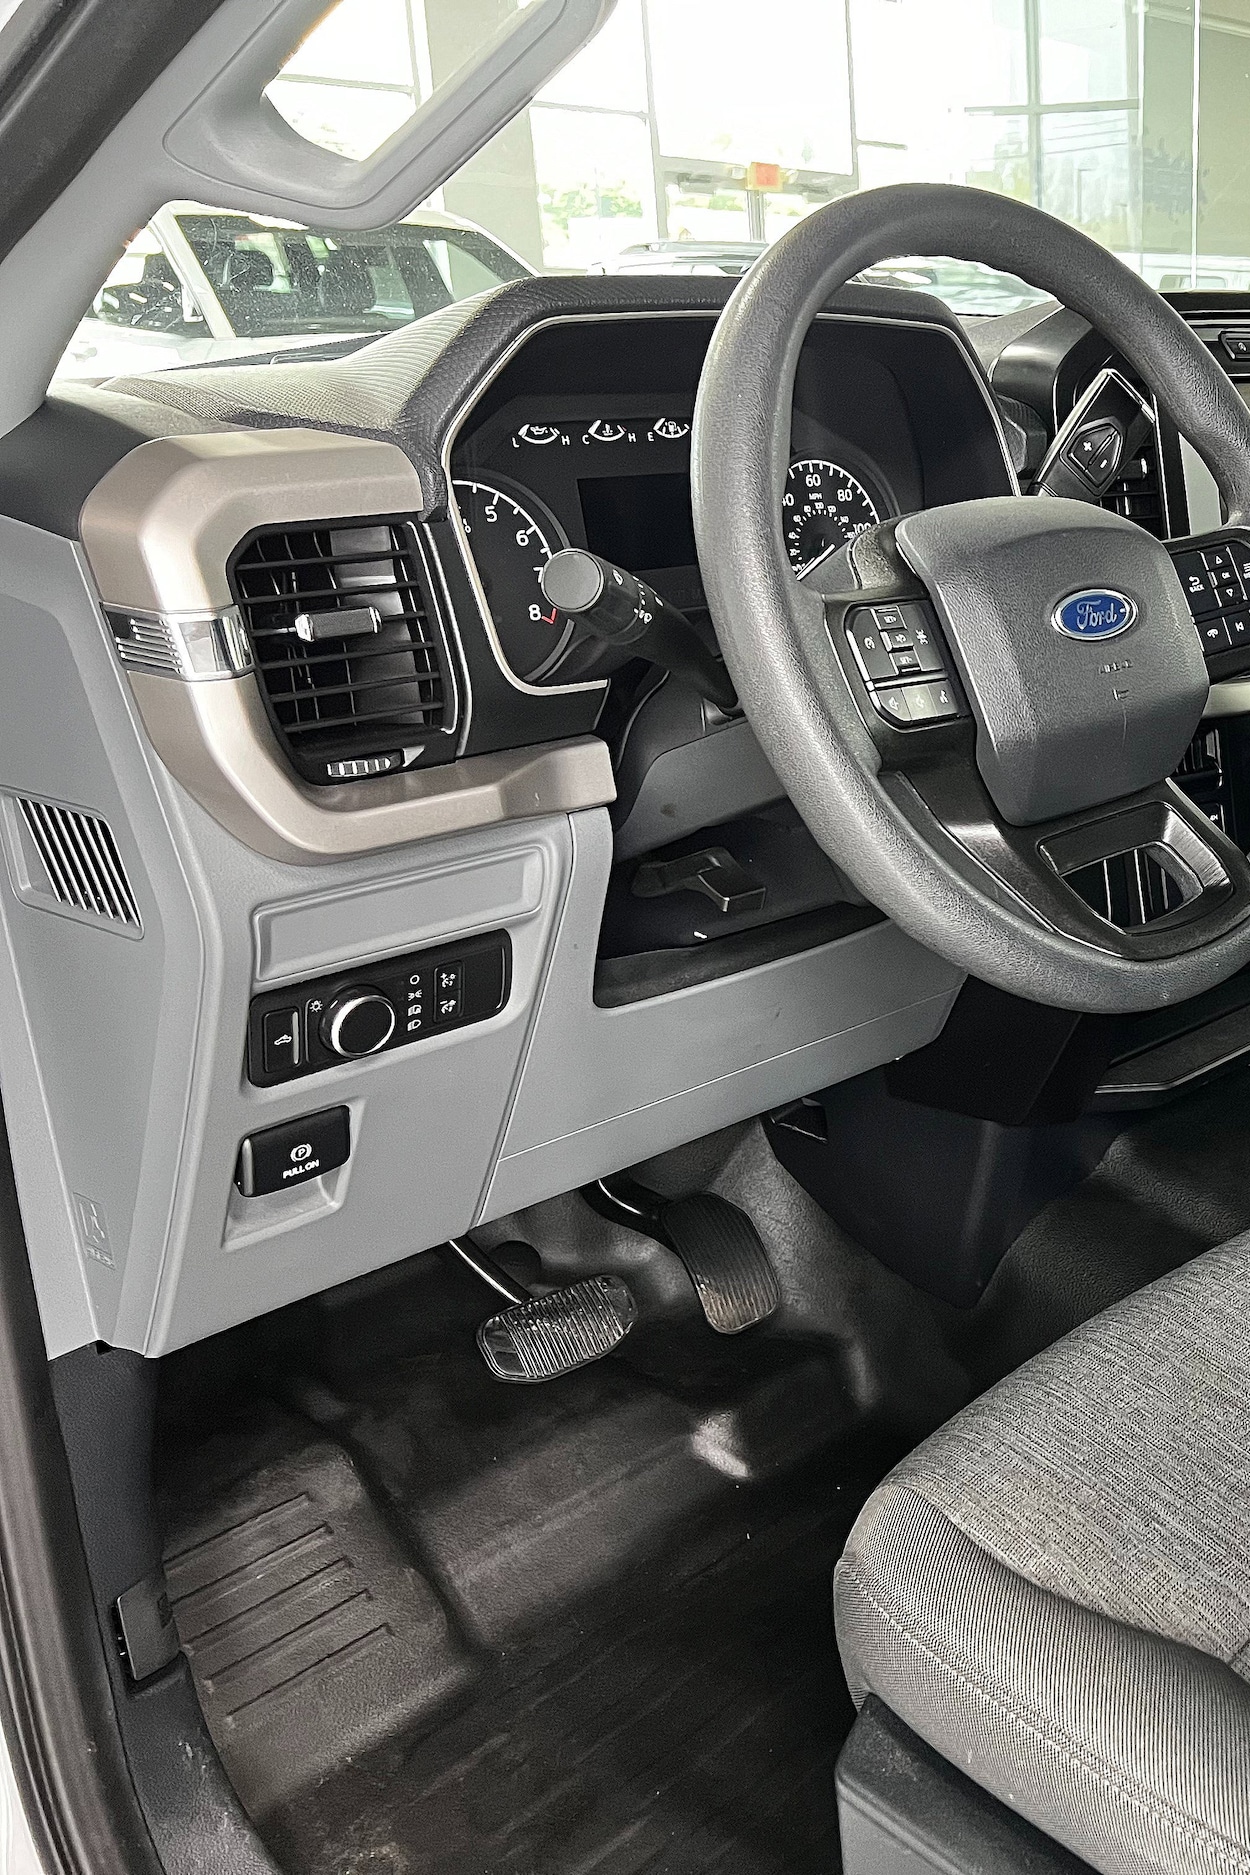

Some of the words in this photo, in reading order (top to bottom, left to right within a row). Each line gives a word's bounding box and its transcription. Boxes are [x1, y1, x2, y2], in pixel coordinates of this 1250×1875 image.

[512, 437, 520, 448] L
[561, 435, 570, 445] H
[582, 433, 590, 444] C
[628, 432, 636, 442] H
[648, 432, 655, 442] E
[805, 474, 821, 487] 60
[837, 488, 853, 501] 80
[485, 506, 497, 522] 5
[516, 530, 529, 546] 6
[533, 566, 544, 583] 7
[529, 604, 541, 621] 8
[1076, 600, 1117, 630] Ford
[283, 1165, 305, 1179] PULL
[305, 1159, 319, 1171] ON
